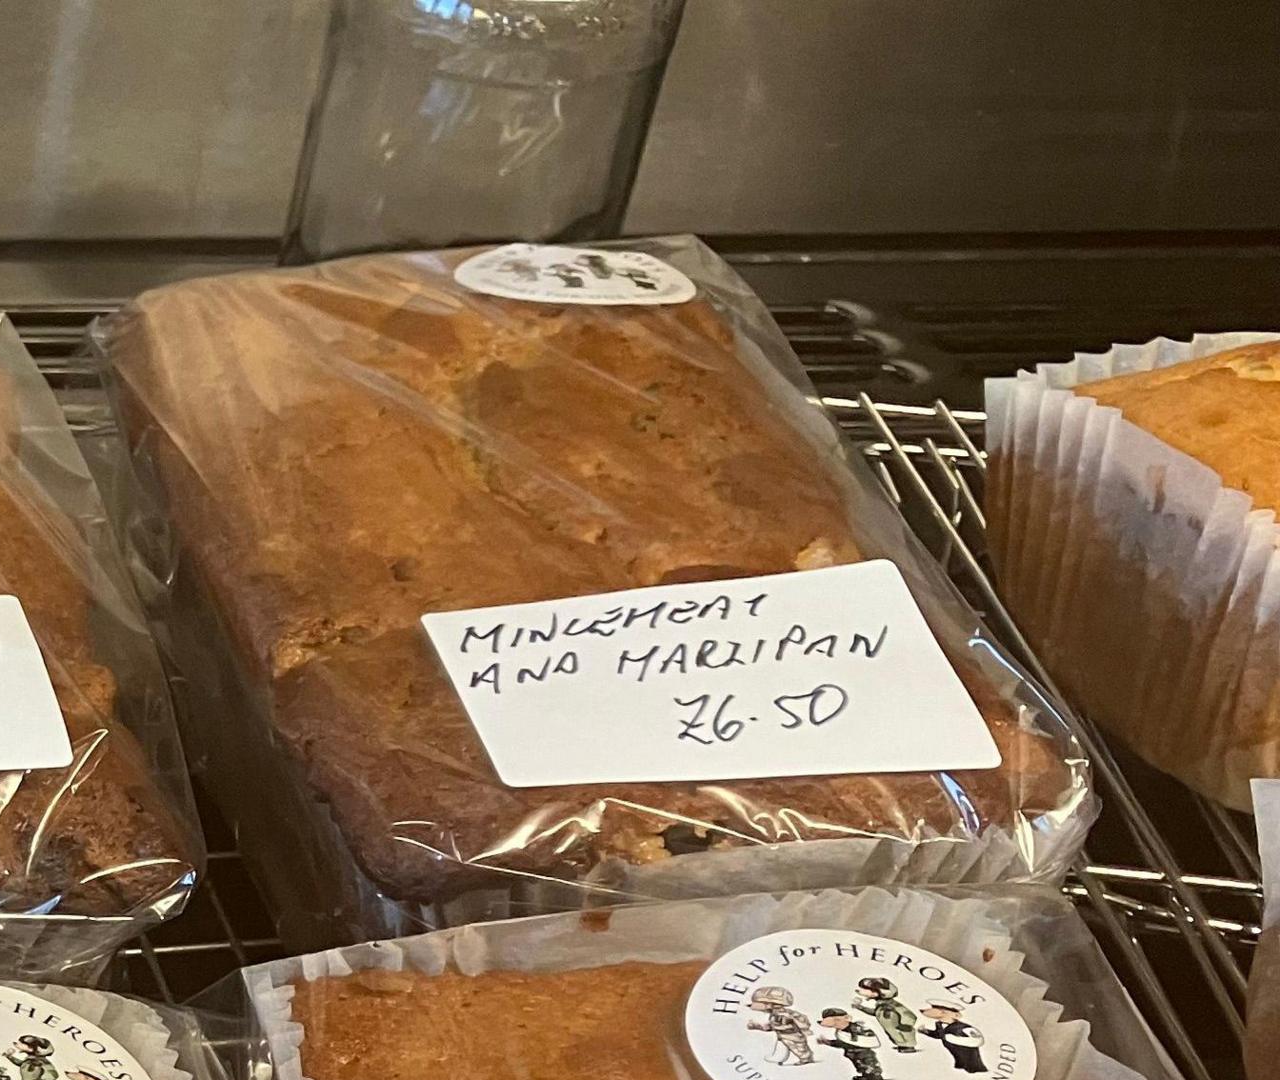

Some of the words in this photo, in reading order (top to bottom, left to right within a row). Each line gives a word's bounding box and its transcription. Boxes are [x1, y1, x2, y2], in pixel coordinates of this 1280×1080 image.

[459, 593, 769, 655] MINCEMEAT
[469, 651, 579, 694] AND
[616, 625, 888, 683] MARZIPAN
[712, 958, 769, 1014] HELP
[778, 945, 822, 967] for
[835, 942, 987, 1007] HEROES
